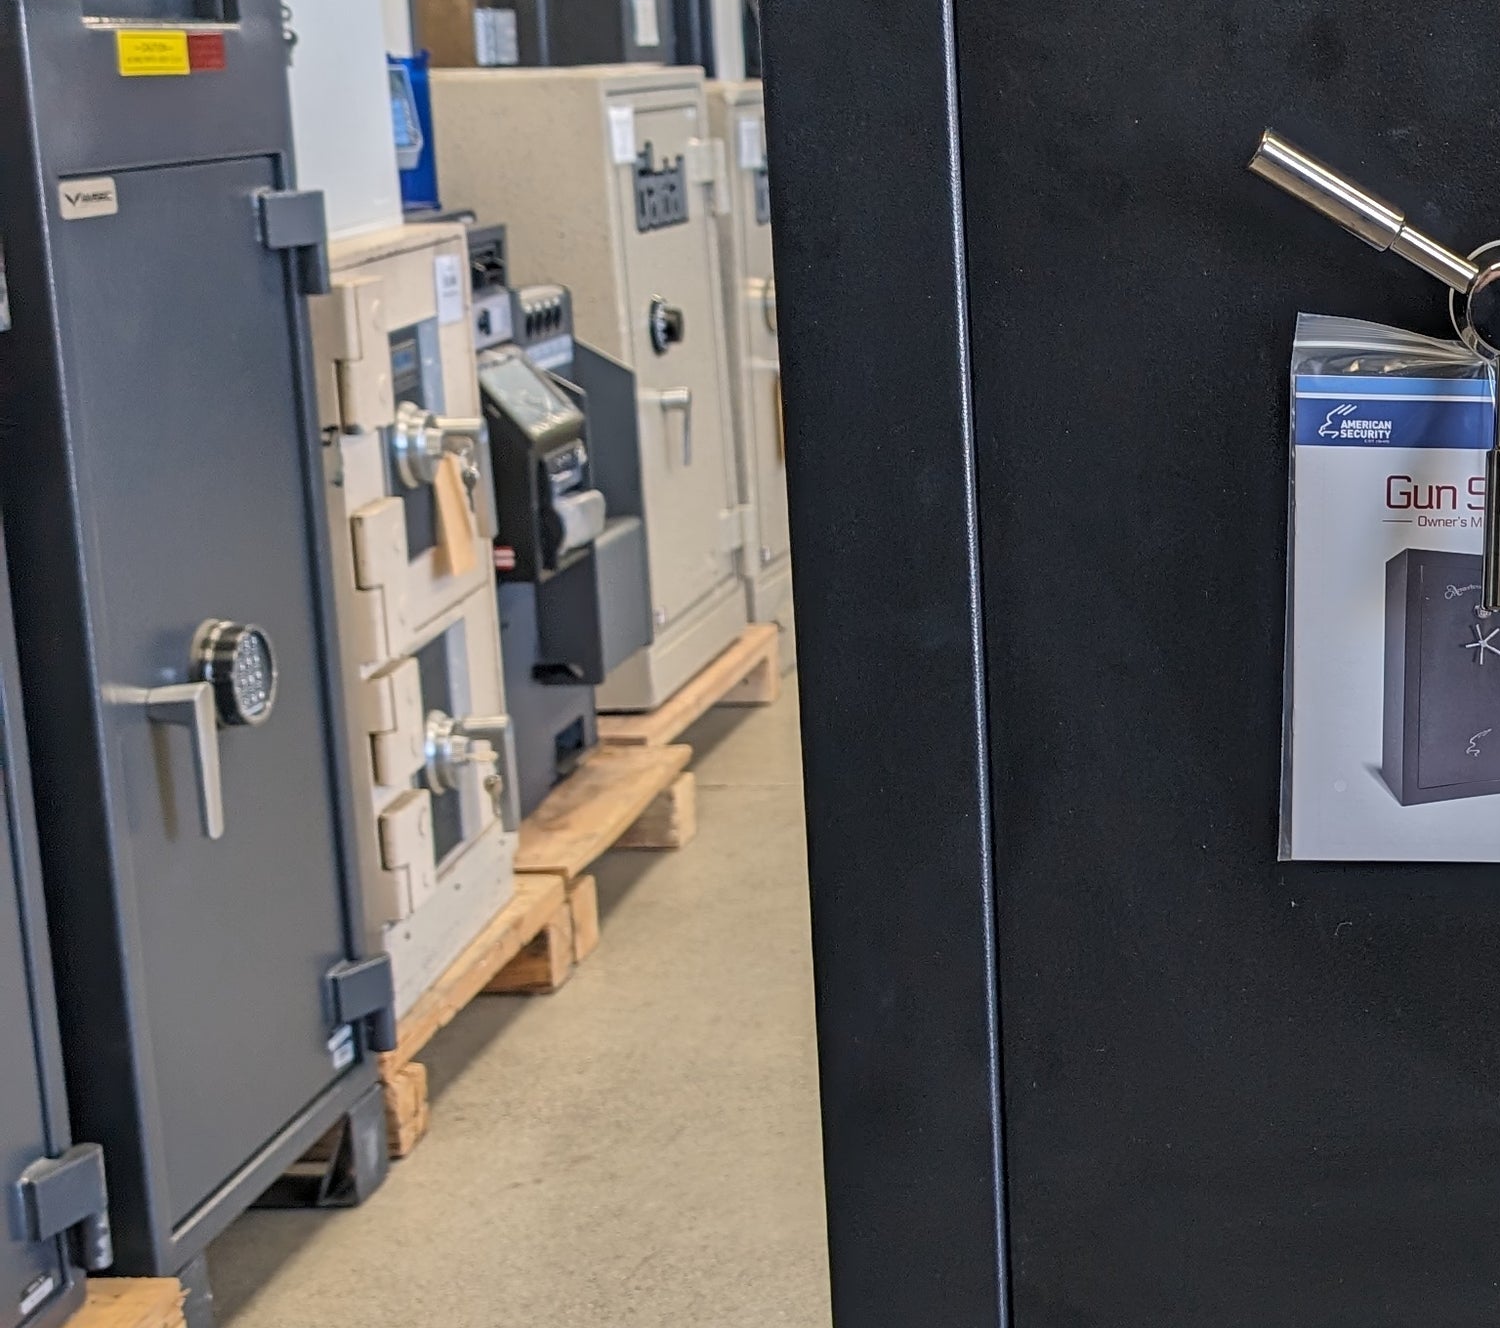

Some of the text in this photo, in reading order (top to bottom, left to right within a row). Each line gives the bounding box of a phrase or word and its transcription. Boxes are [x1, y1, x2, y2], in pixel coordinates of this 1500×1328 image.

[1340, 419, 1392, 430] AMERICAN
[1340, 429, 1392, 439] SECURITY
[1386, 475, 1457, 510] Gun
[1417, 515, 1468, 528] Owner's
